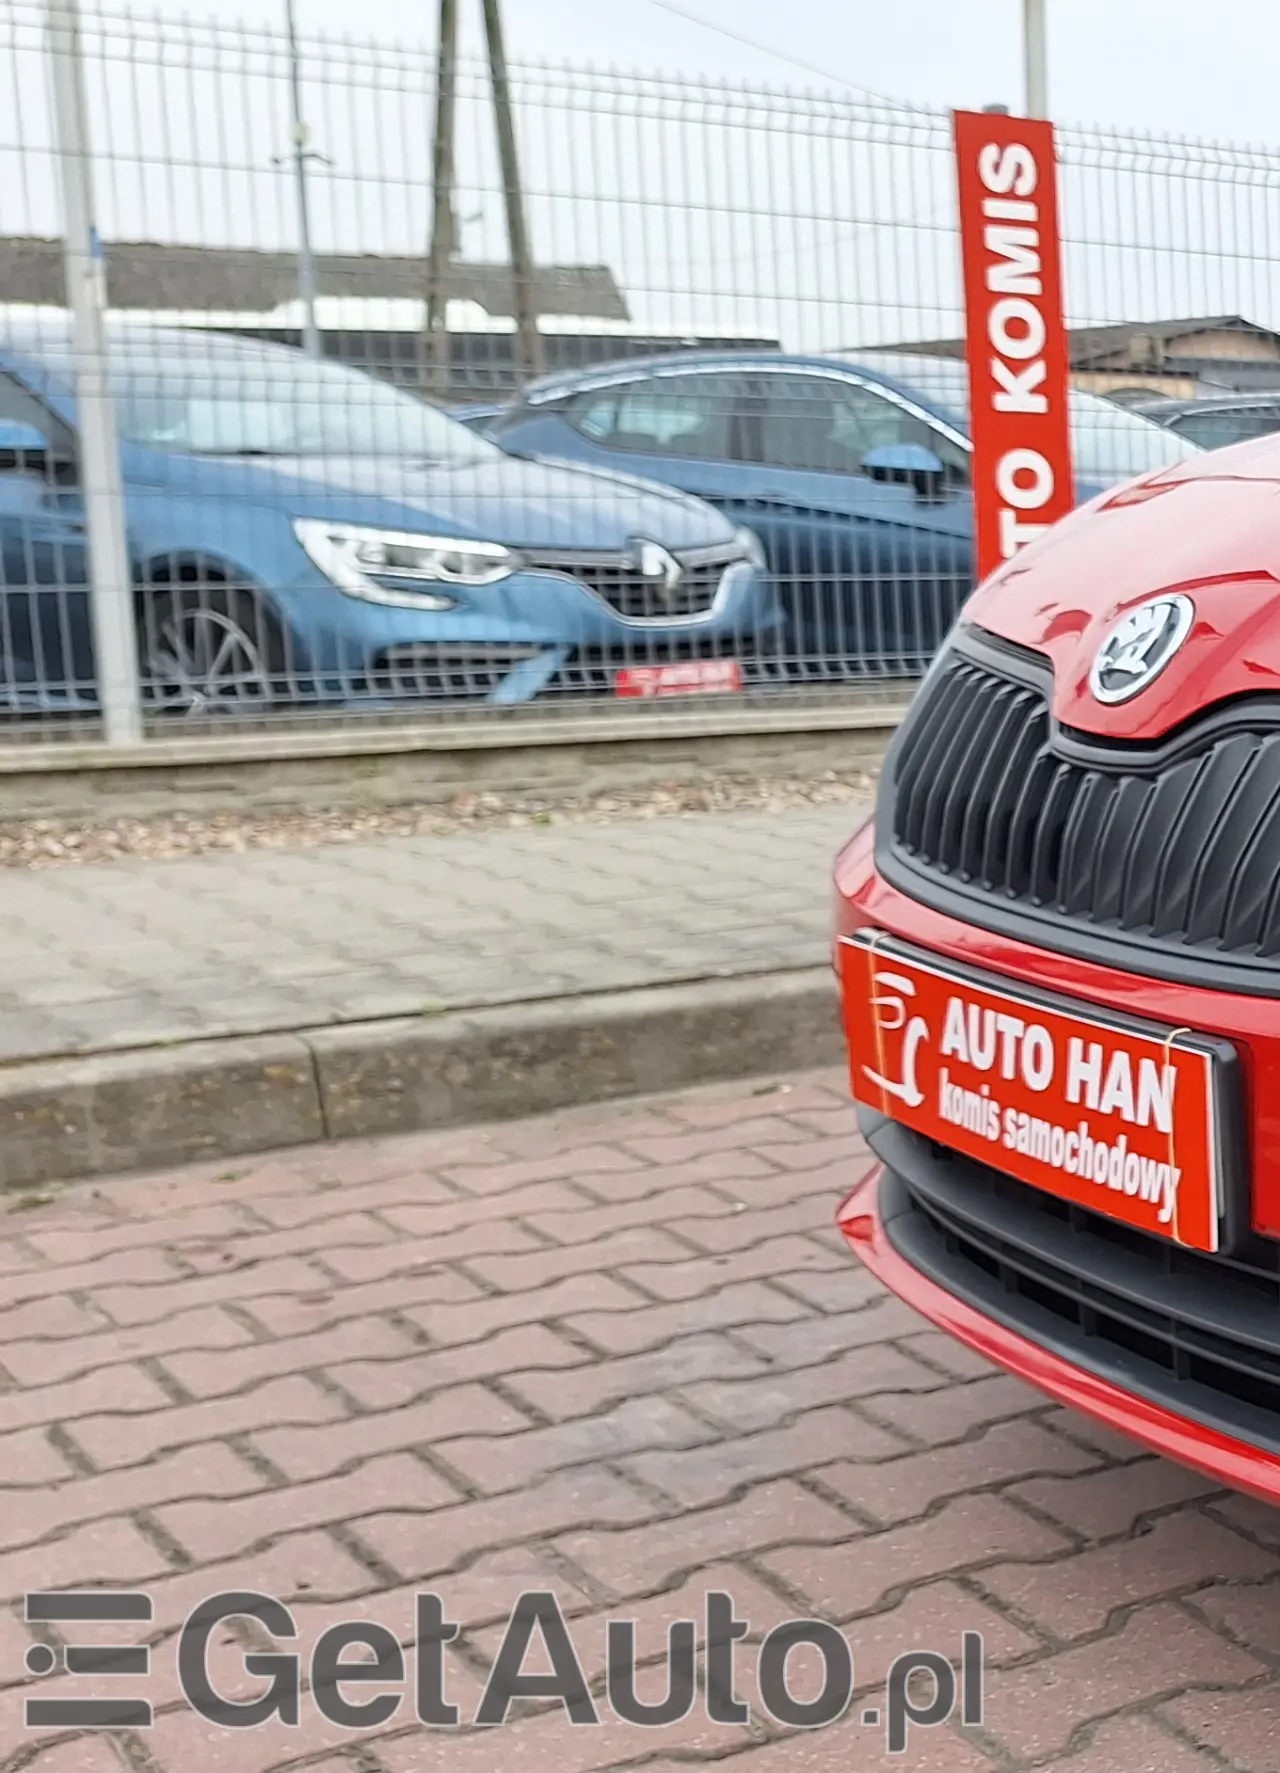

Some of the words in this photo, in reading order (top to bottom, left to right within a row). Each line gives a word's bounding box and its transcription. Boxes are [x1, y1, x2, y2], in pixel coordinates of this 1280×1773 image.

[979, 142, 1048, 415] KOMIS
[997, 447, 1054, 559] TO
[940, 997, 1054, 1091] AUTO
[1066, 1036, 1177, 1133] HAN
[939, 1067, 1001, 1142] komis
[1003, 1106, 1180, 1222] samochodowy
